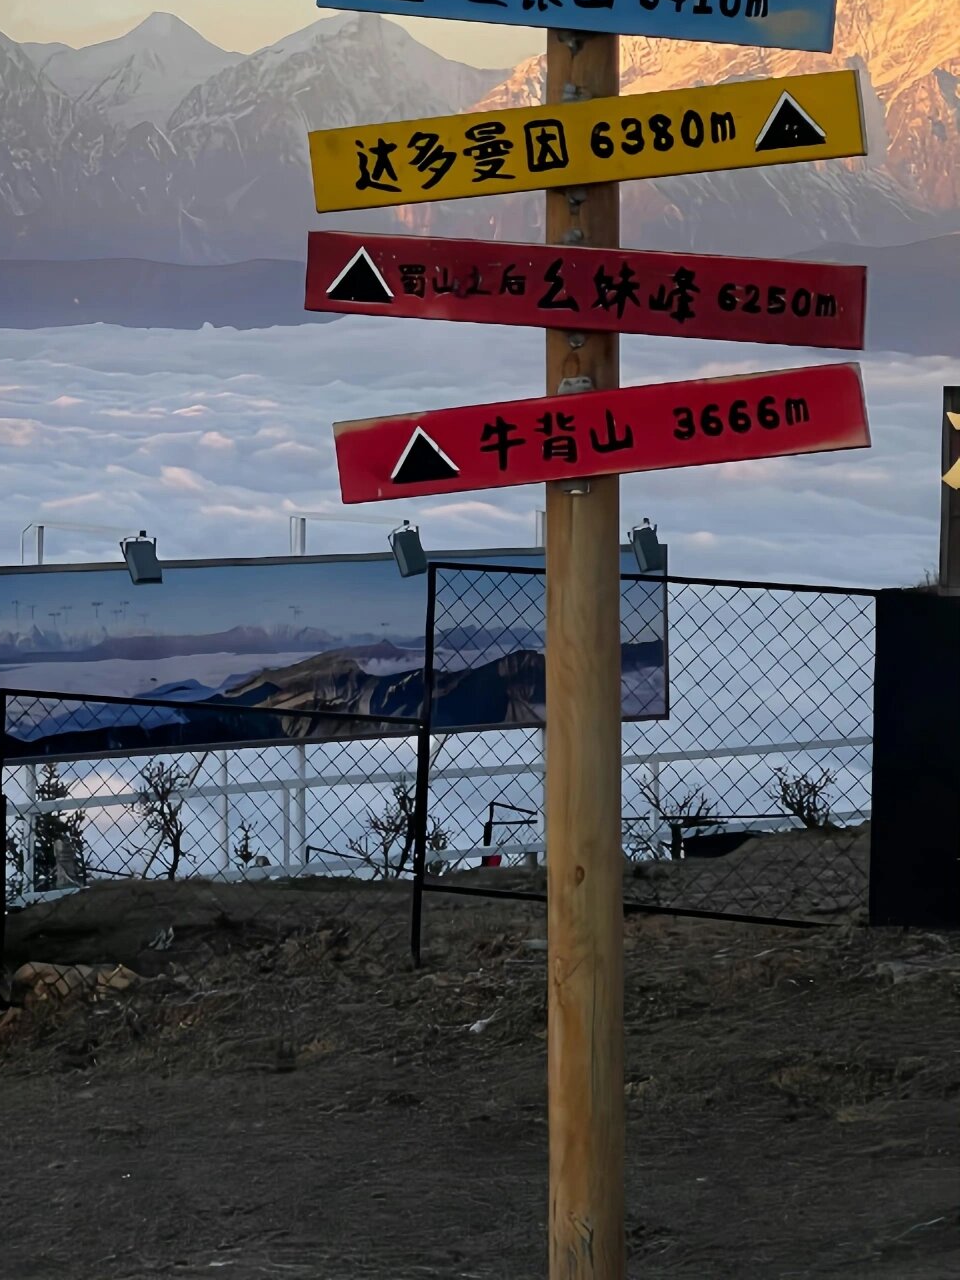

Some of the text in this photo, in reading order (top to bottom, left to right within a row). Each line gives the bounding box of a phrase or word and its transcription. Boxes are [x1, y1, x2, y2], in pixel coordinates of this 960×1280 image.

[355, 109, 736, 193] 达多曼因 6380m
[717, 282, 837, 318] 6250m
[480, 395, 810, 471] 牛背山 3666m
